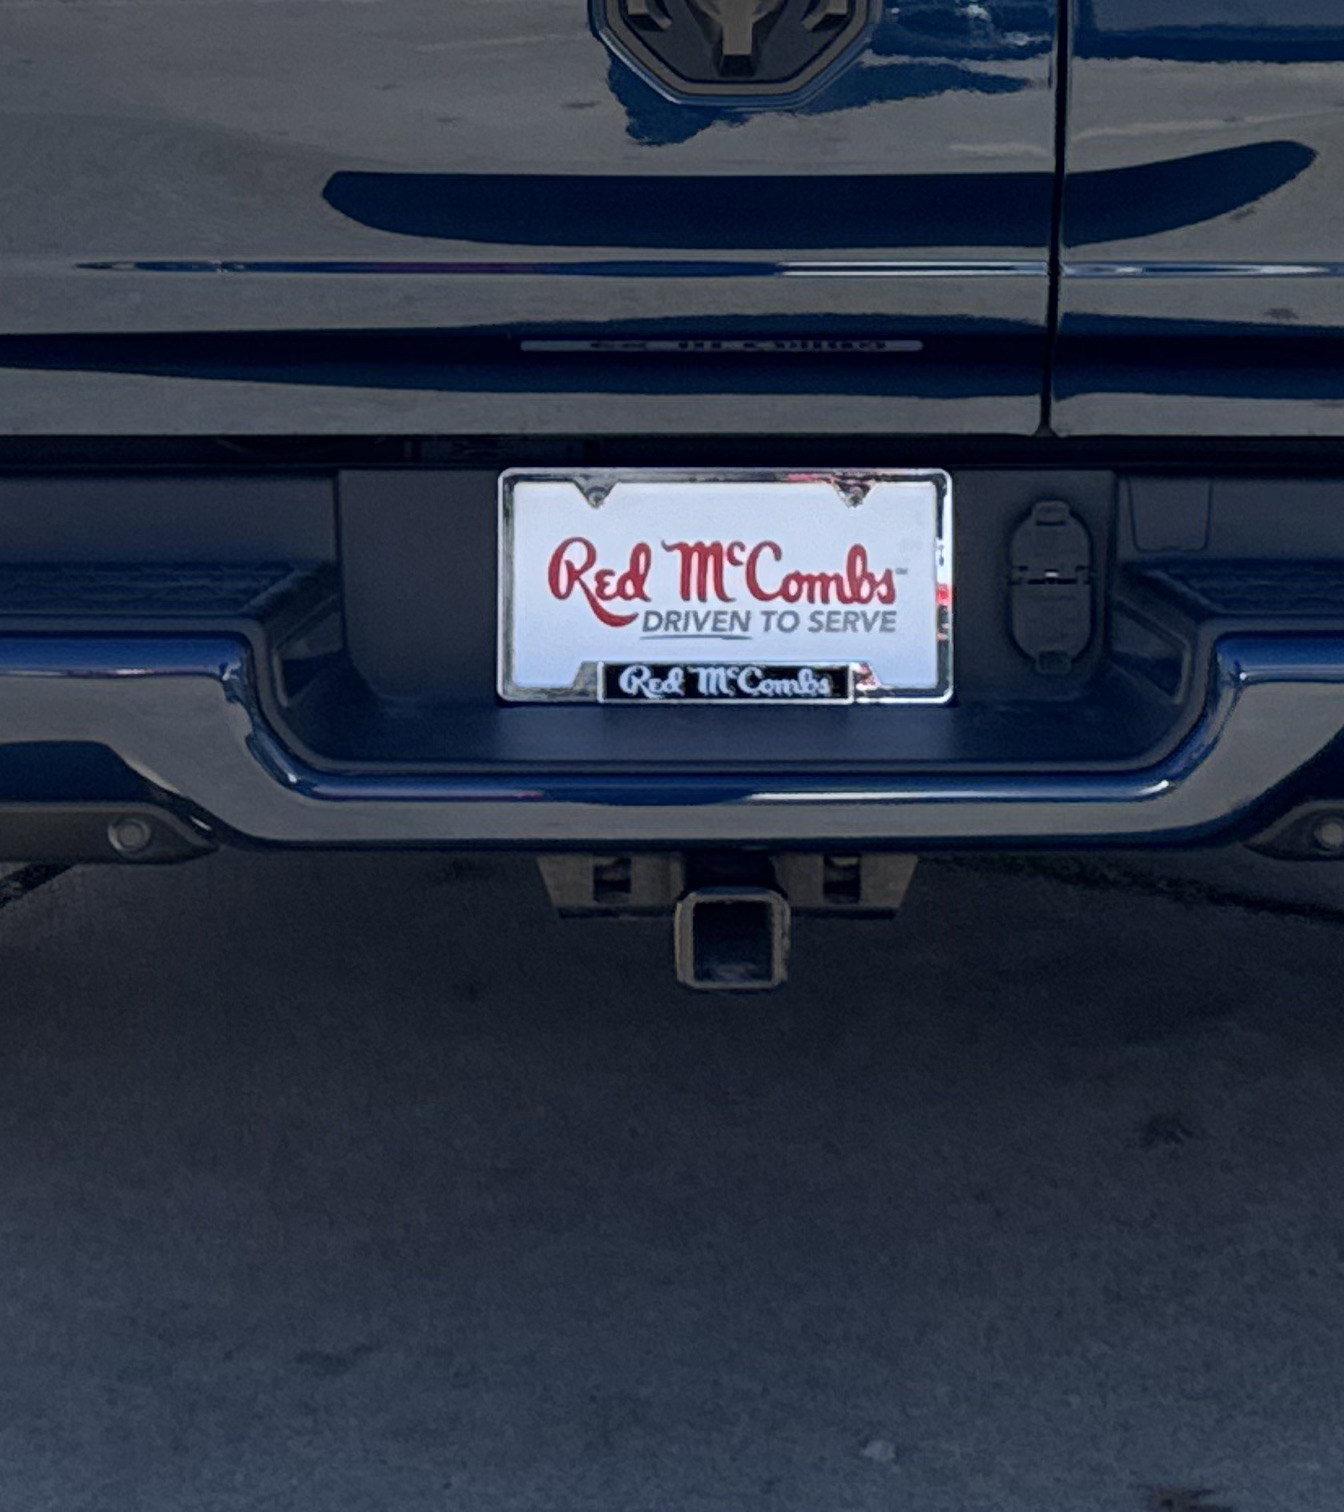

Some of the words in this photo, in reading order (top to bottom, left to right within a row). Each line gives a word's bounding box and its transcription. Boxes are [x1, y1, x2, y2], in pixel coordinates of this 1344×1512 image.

[548, 536, 652, 628] Red
[661, 539, 897, 605] McCombs
[641, 609, 752, 633] DRIVEN
[761, 610, 801, 633] TO
[807, 609, 898, 633] SERVE
[619, 665, 684, 699] Red
[687, 666, 832, 698] McCombs
